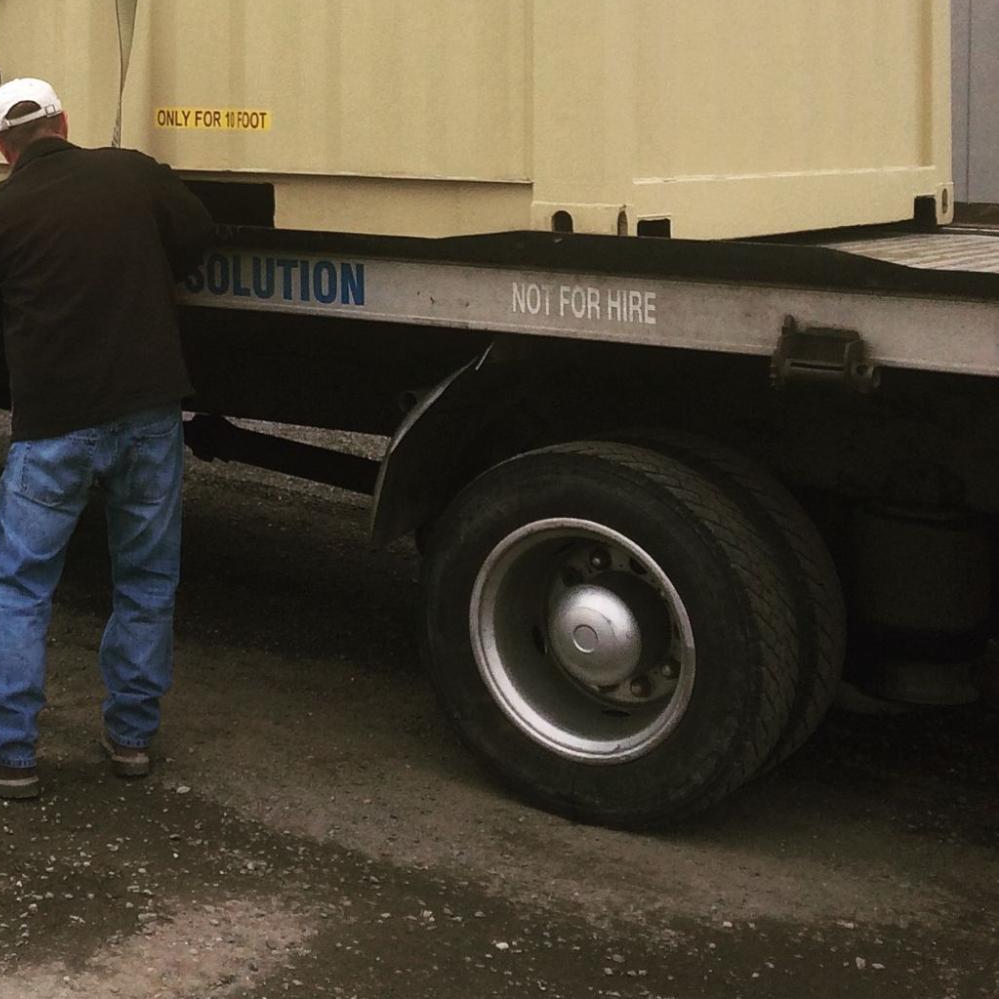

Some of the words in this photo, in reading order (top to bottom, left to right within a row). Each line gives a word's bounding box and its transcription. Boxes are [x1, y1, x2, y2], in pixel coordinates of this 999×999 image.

[157, 109, 191, 127] ONLY
[195, 110, 221, 128] FOR
[236, 111, 267, 129] FOOT
[511, 281, 551, 316] NOT
[559, 284, 601, 321] FOR
[607, 288, 657, 325] HIRE
